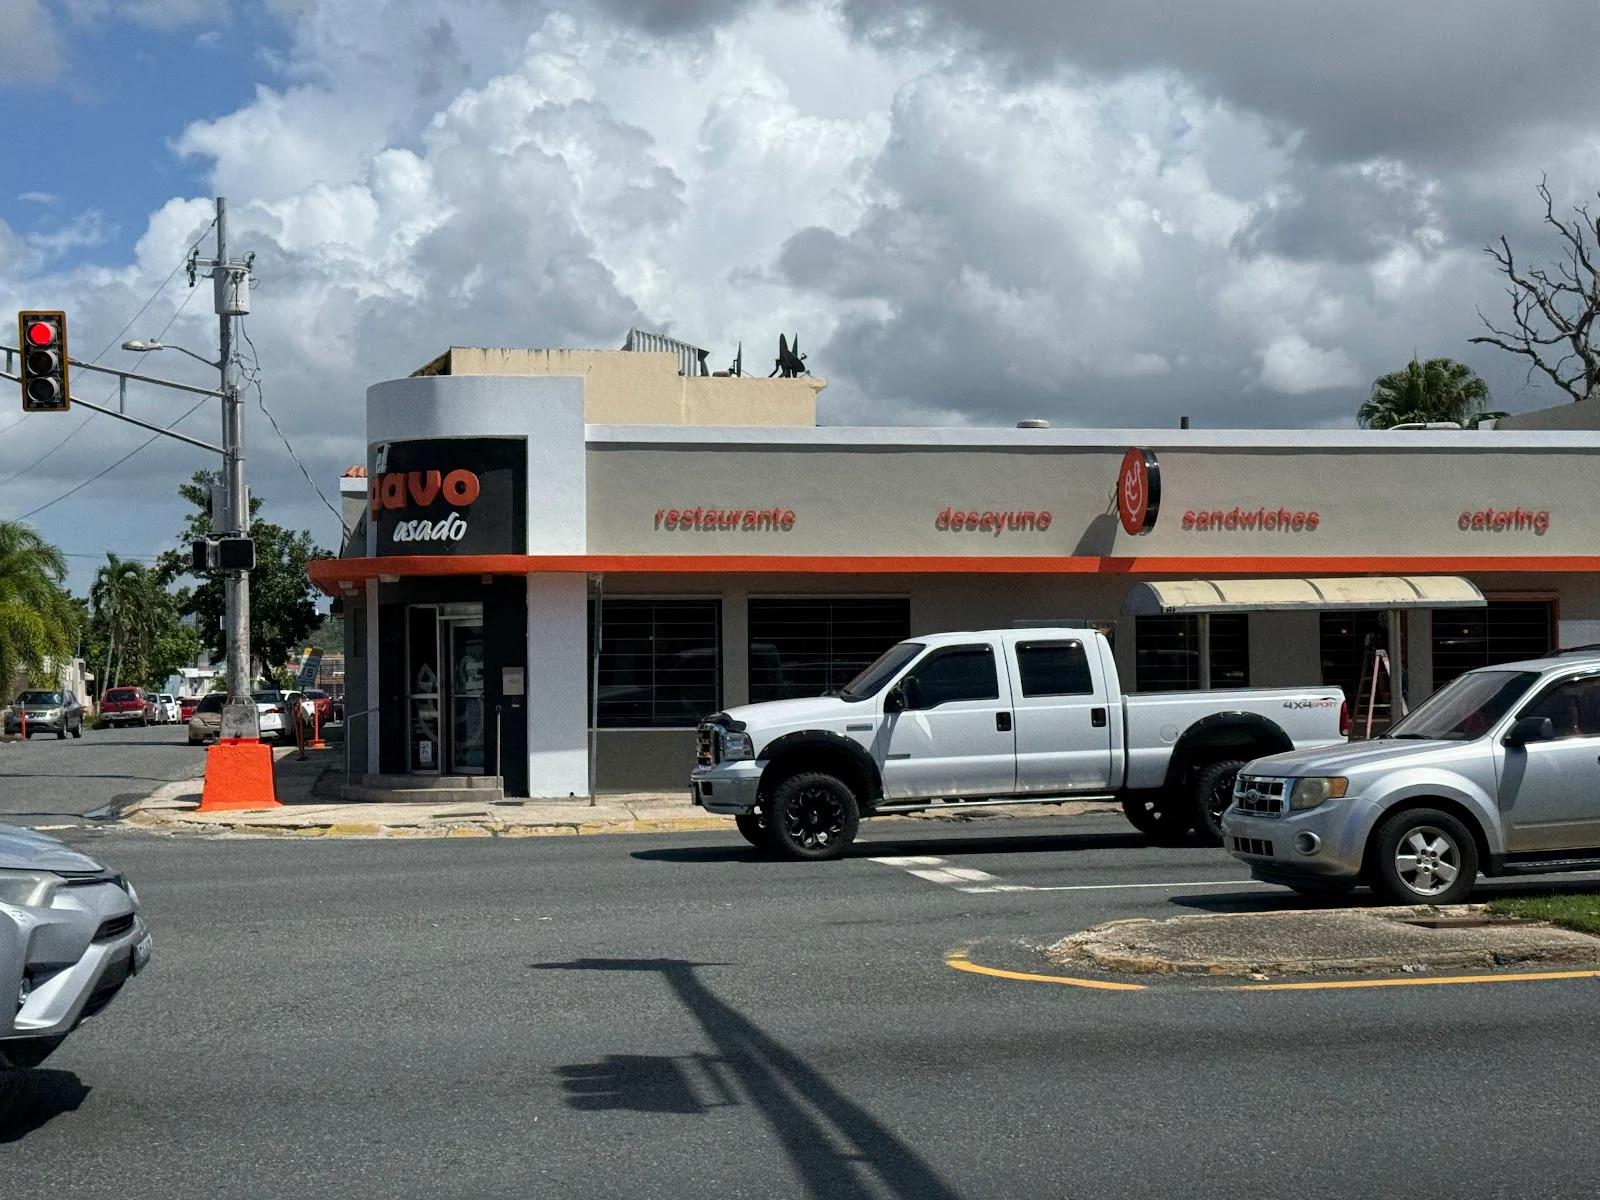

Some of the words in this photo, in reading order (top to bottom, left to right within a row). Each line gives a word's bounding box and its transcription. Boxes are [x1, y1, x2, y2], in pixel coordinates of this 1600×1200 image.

[376, 443, 391, 474] el
[370, 469, 480, 521] pavo
[393, 512, 467, 542] asado
[656, 506, 796, 529] restaurante
[937, 507, 1052, 533] desayuno
[1183, 506, 1320, 529] sandwiches
[1459, 507, 1549, 532] catering
